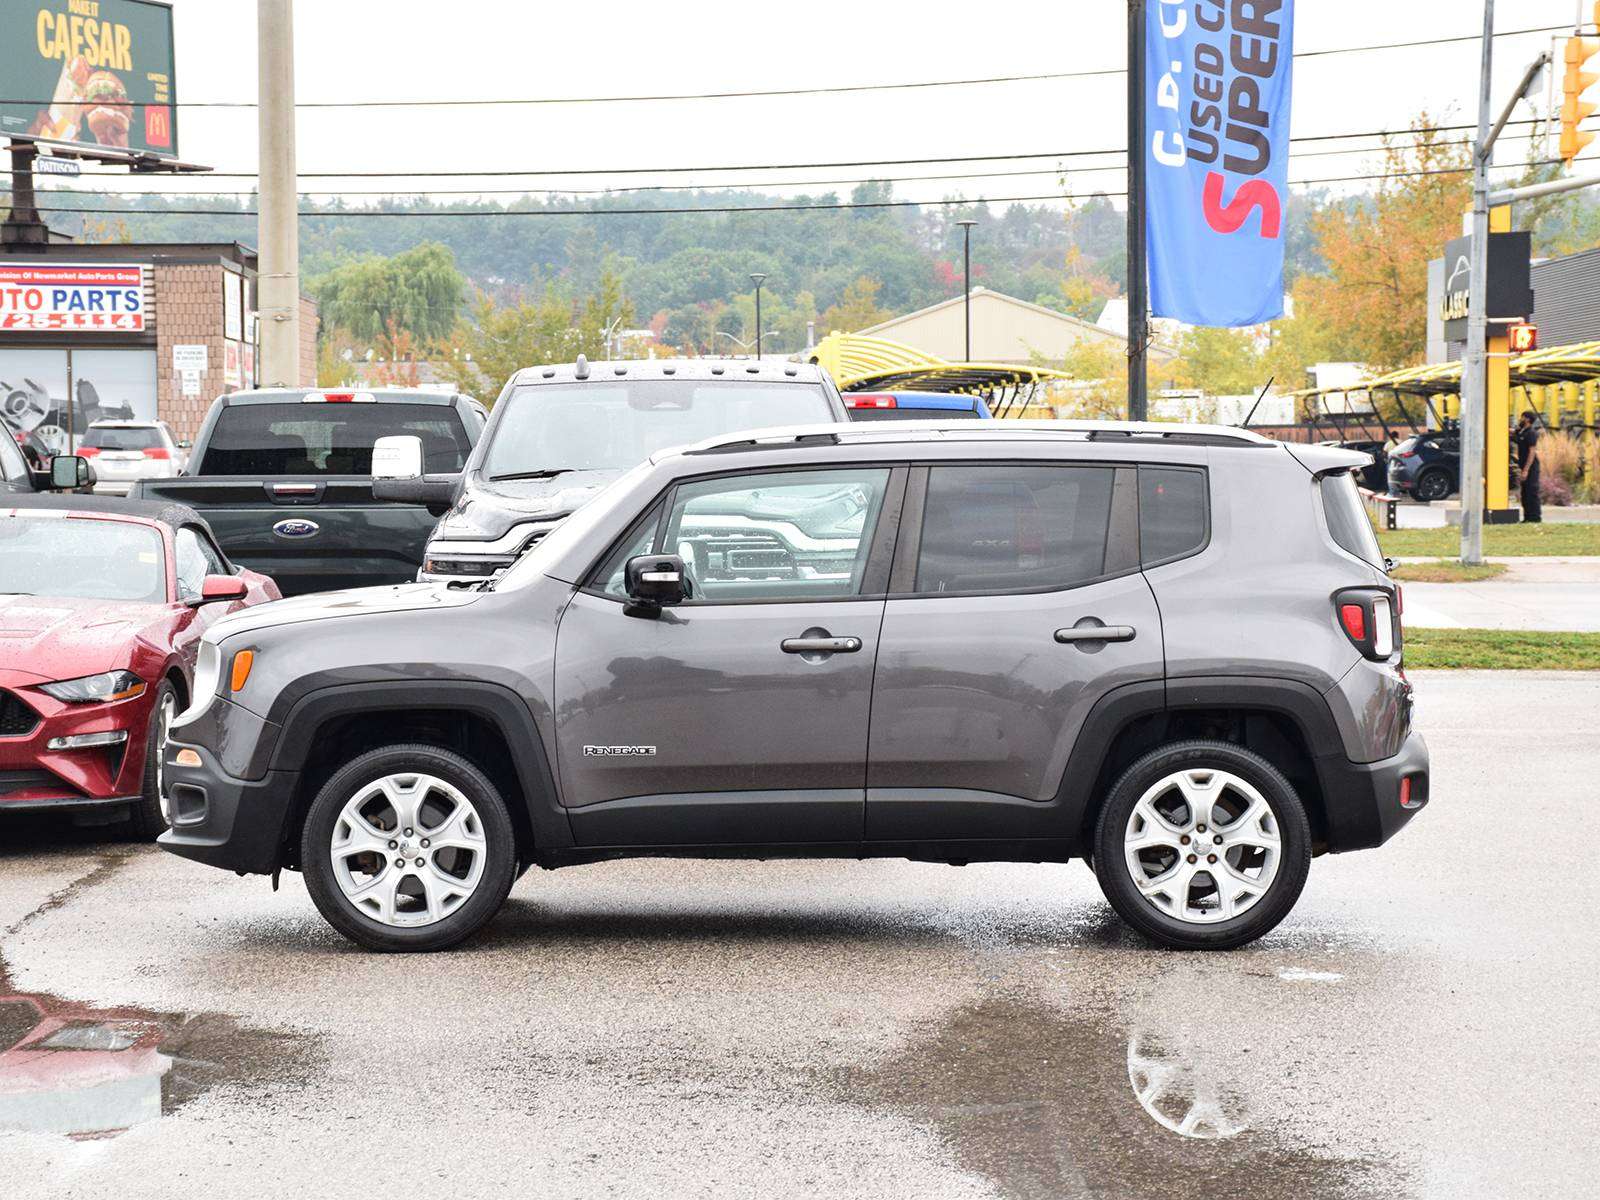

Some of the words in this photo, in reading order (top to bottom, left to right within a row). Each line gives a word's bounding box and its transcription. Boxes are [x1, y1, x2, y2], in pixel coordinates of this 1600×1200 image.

[1159, 0, 1188, 38] C
[37, 9, 133, 71] CAESAR
[1187, 42, 1225, 163] USED
[34, 272, 77, 280] Newmarket
[96, 272, 115, 280] Parts
[116, 272, 139, 281] Group
[0, 288, 43, 310] TO
[52, 290, 140, 312] PARTS
[583, 745, 656, 756] RENEGADE
